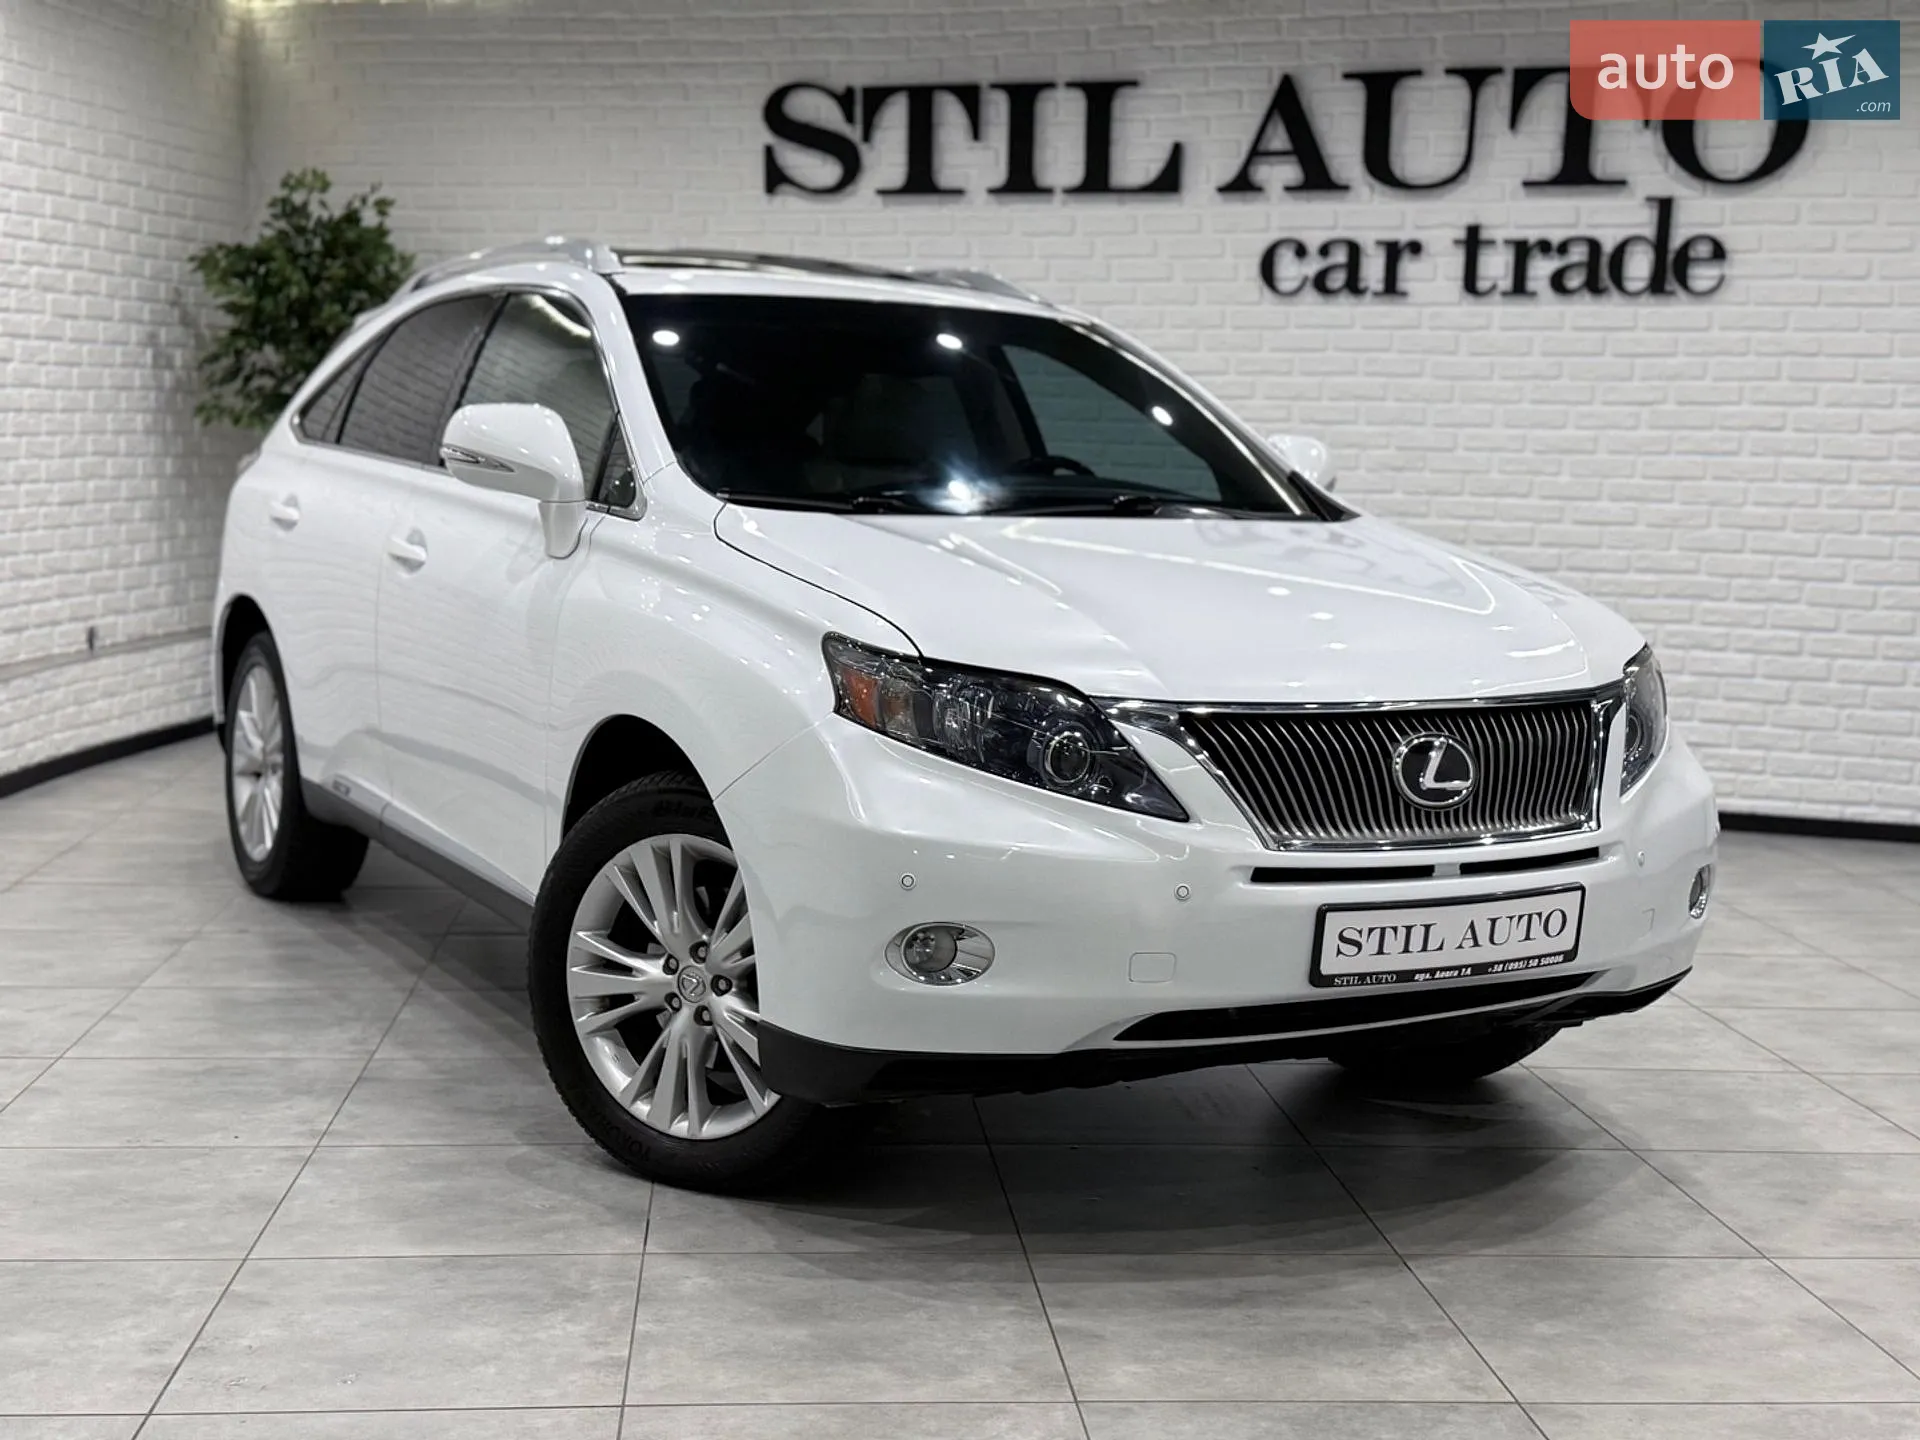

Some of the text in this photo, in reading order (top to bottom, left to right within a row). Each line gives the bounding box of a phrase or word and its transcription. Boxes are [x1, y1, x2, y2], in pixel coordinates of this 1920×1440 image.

[763, 58, 1811, 196] STIL AUTO
[1260, 197, 1728, 298] car trade
[1336, 908, 1569, 958] STIL AUTO
[1334, 973, 1397, 986] STIL AUTO
